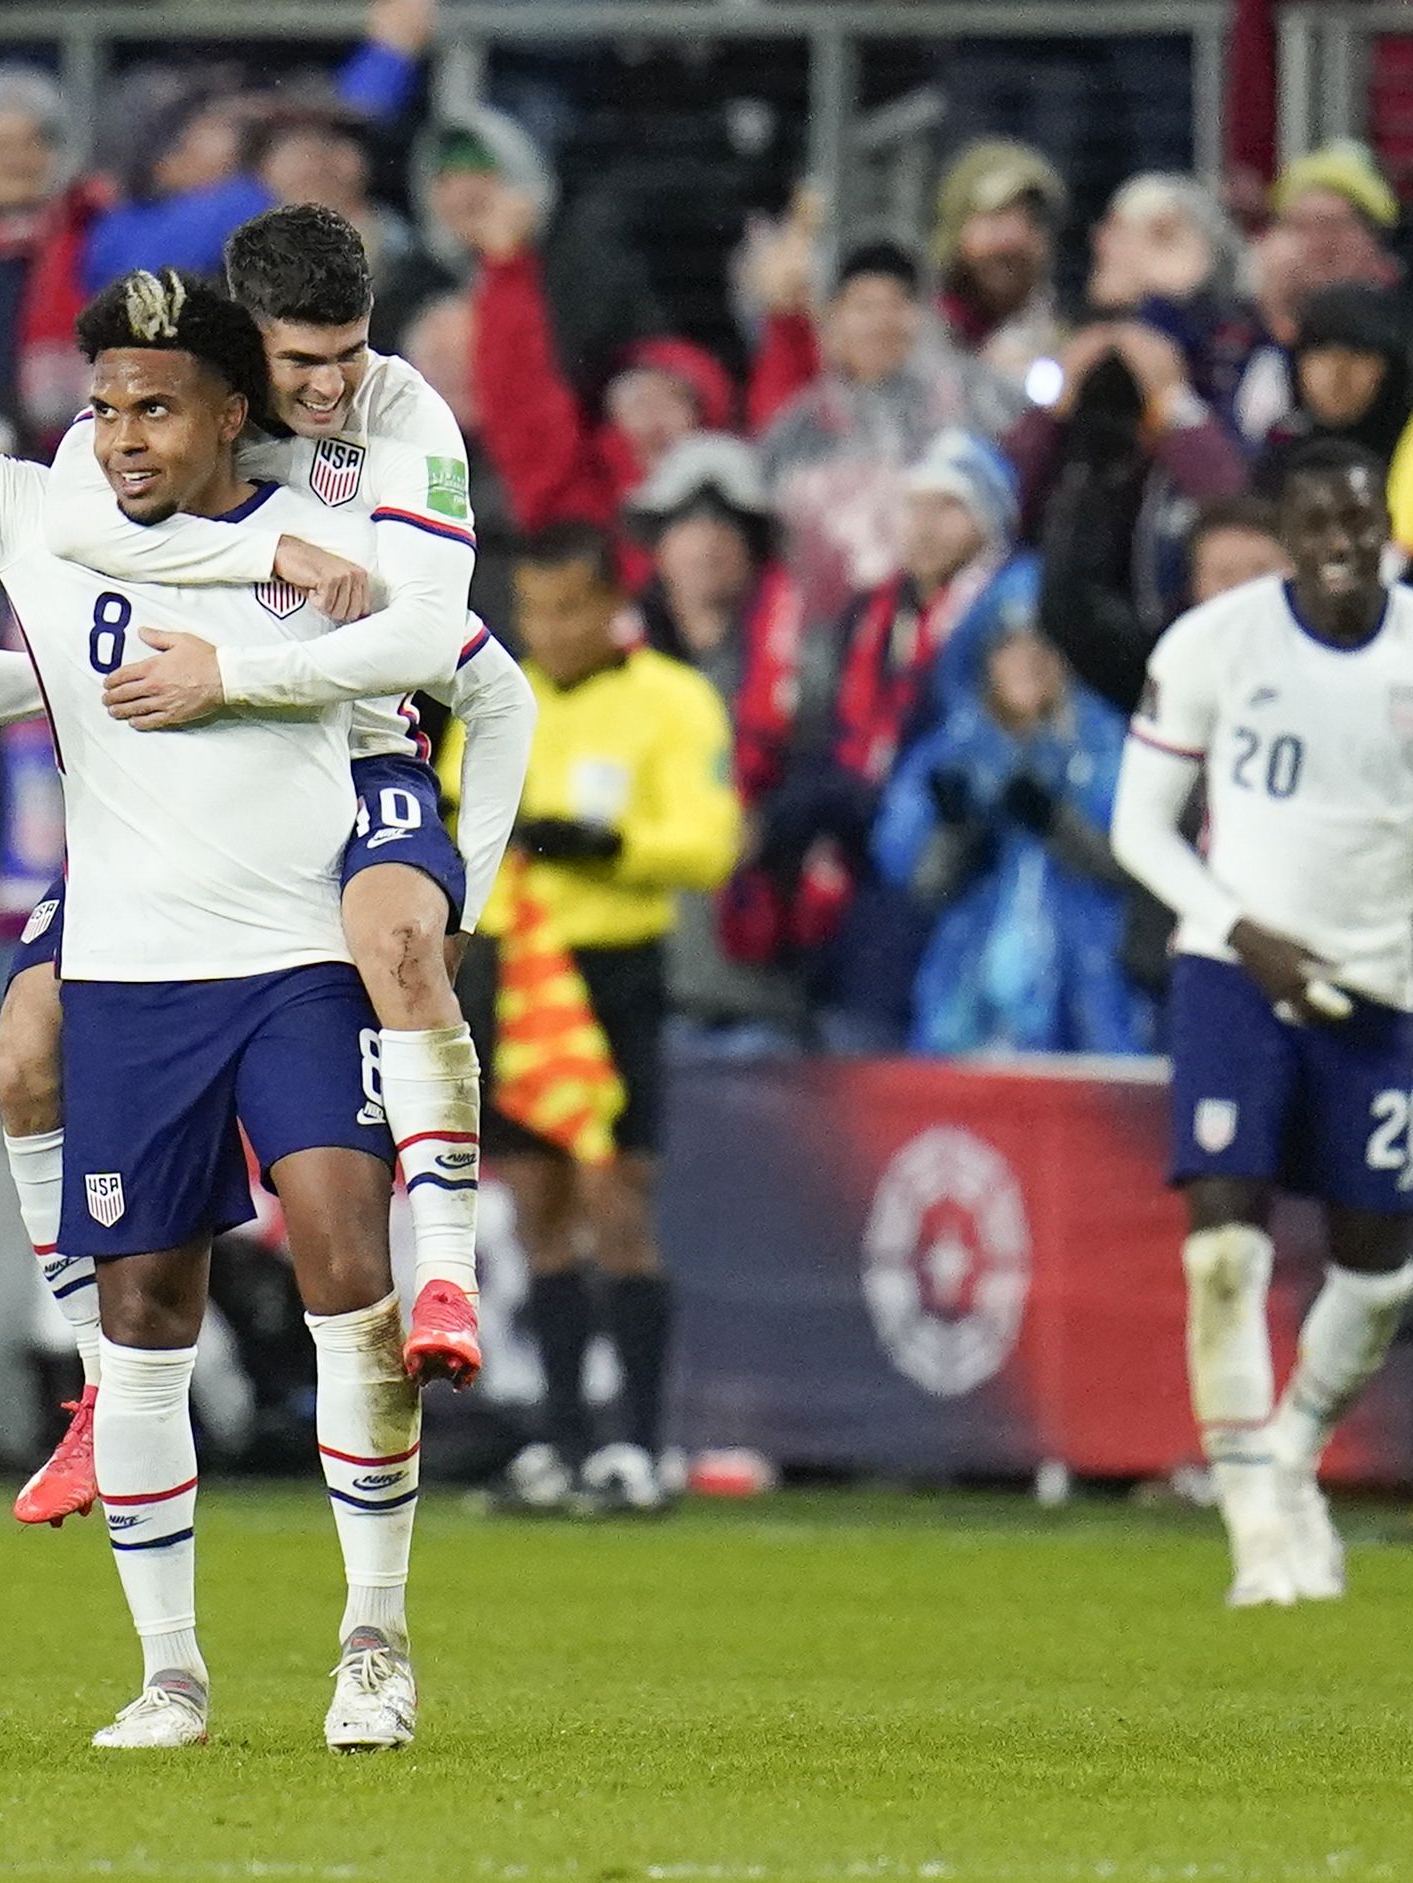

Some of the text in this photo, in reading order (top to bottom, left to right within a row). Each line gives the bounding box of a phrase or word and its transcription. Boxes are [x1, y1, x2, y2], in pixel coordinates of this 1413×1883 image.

[321, 440, 359, 469] USA
[89, 591, 132, 674] 8
[1233, 726, 1305, 798] 20
[89, 1177, 119, 1196] USA
